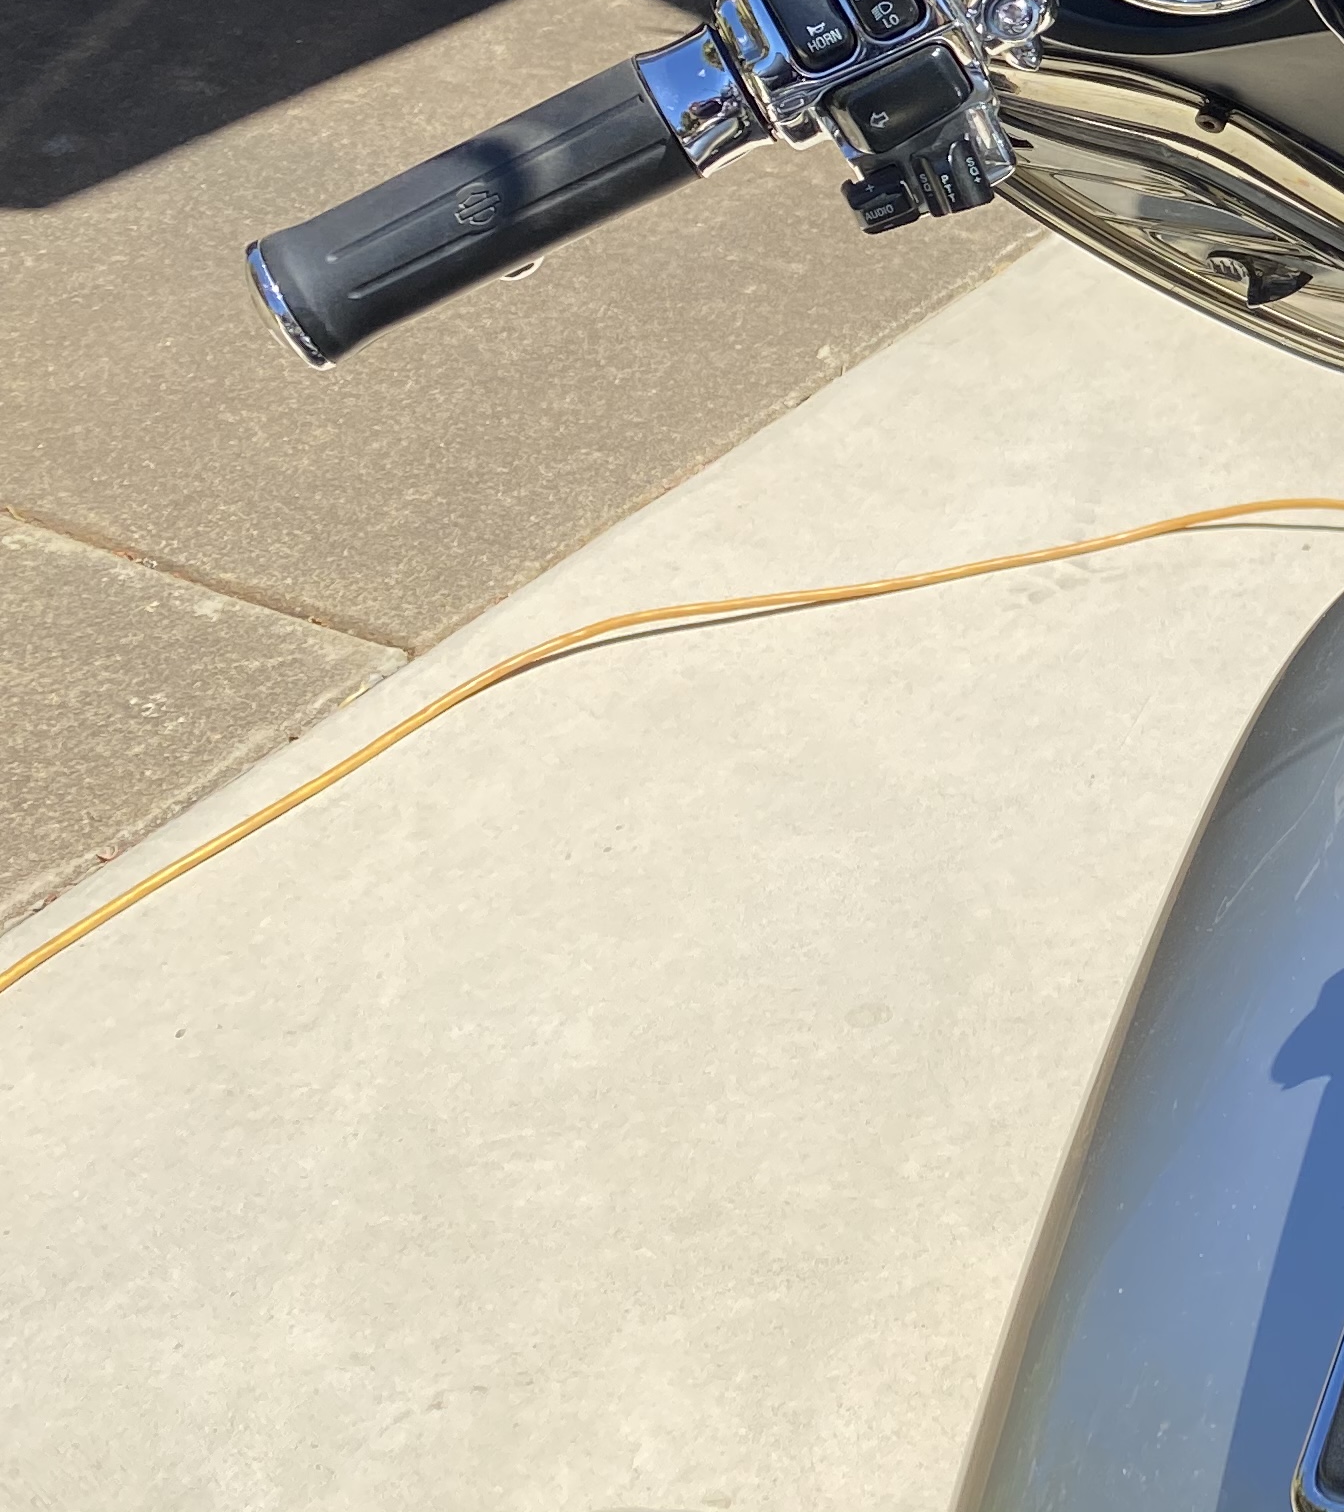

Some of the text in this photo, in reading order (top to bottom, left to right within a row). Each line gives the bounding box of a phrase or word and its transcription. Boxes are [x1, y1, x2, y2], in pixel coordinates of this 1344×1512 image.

[881, 13, 900, 31] LO
[806, 28, 843, 55] HORN
[940, 174, 956, 203] PTT
[865, 204, 895, 221] AUDIO
